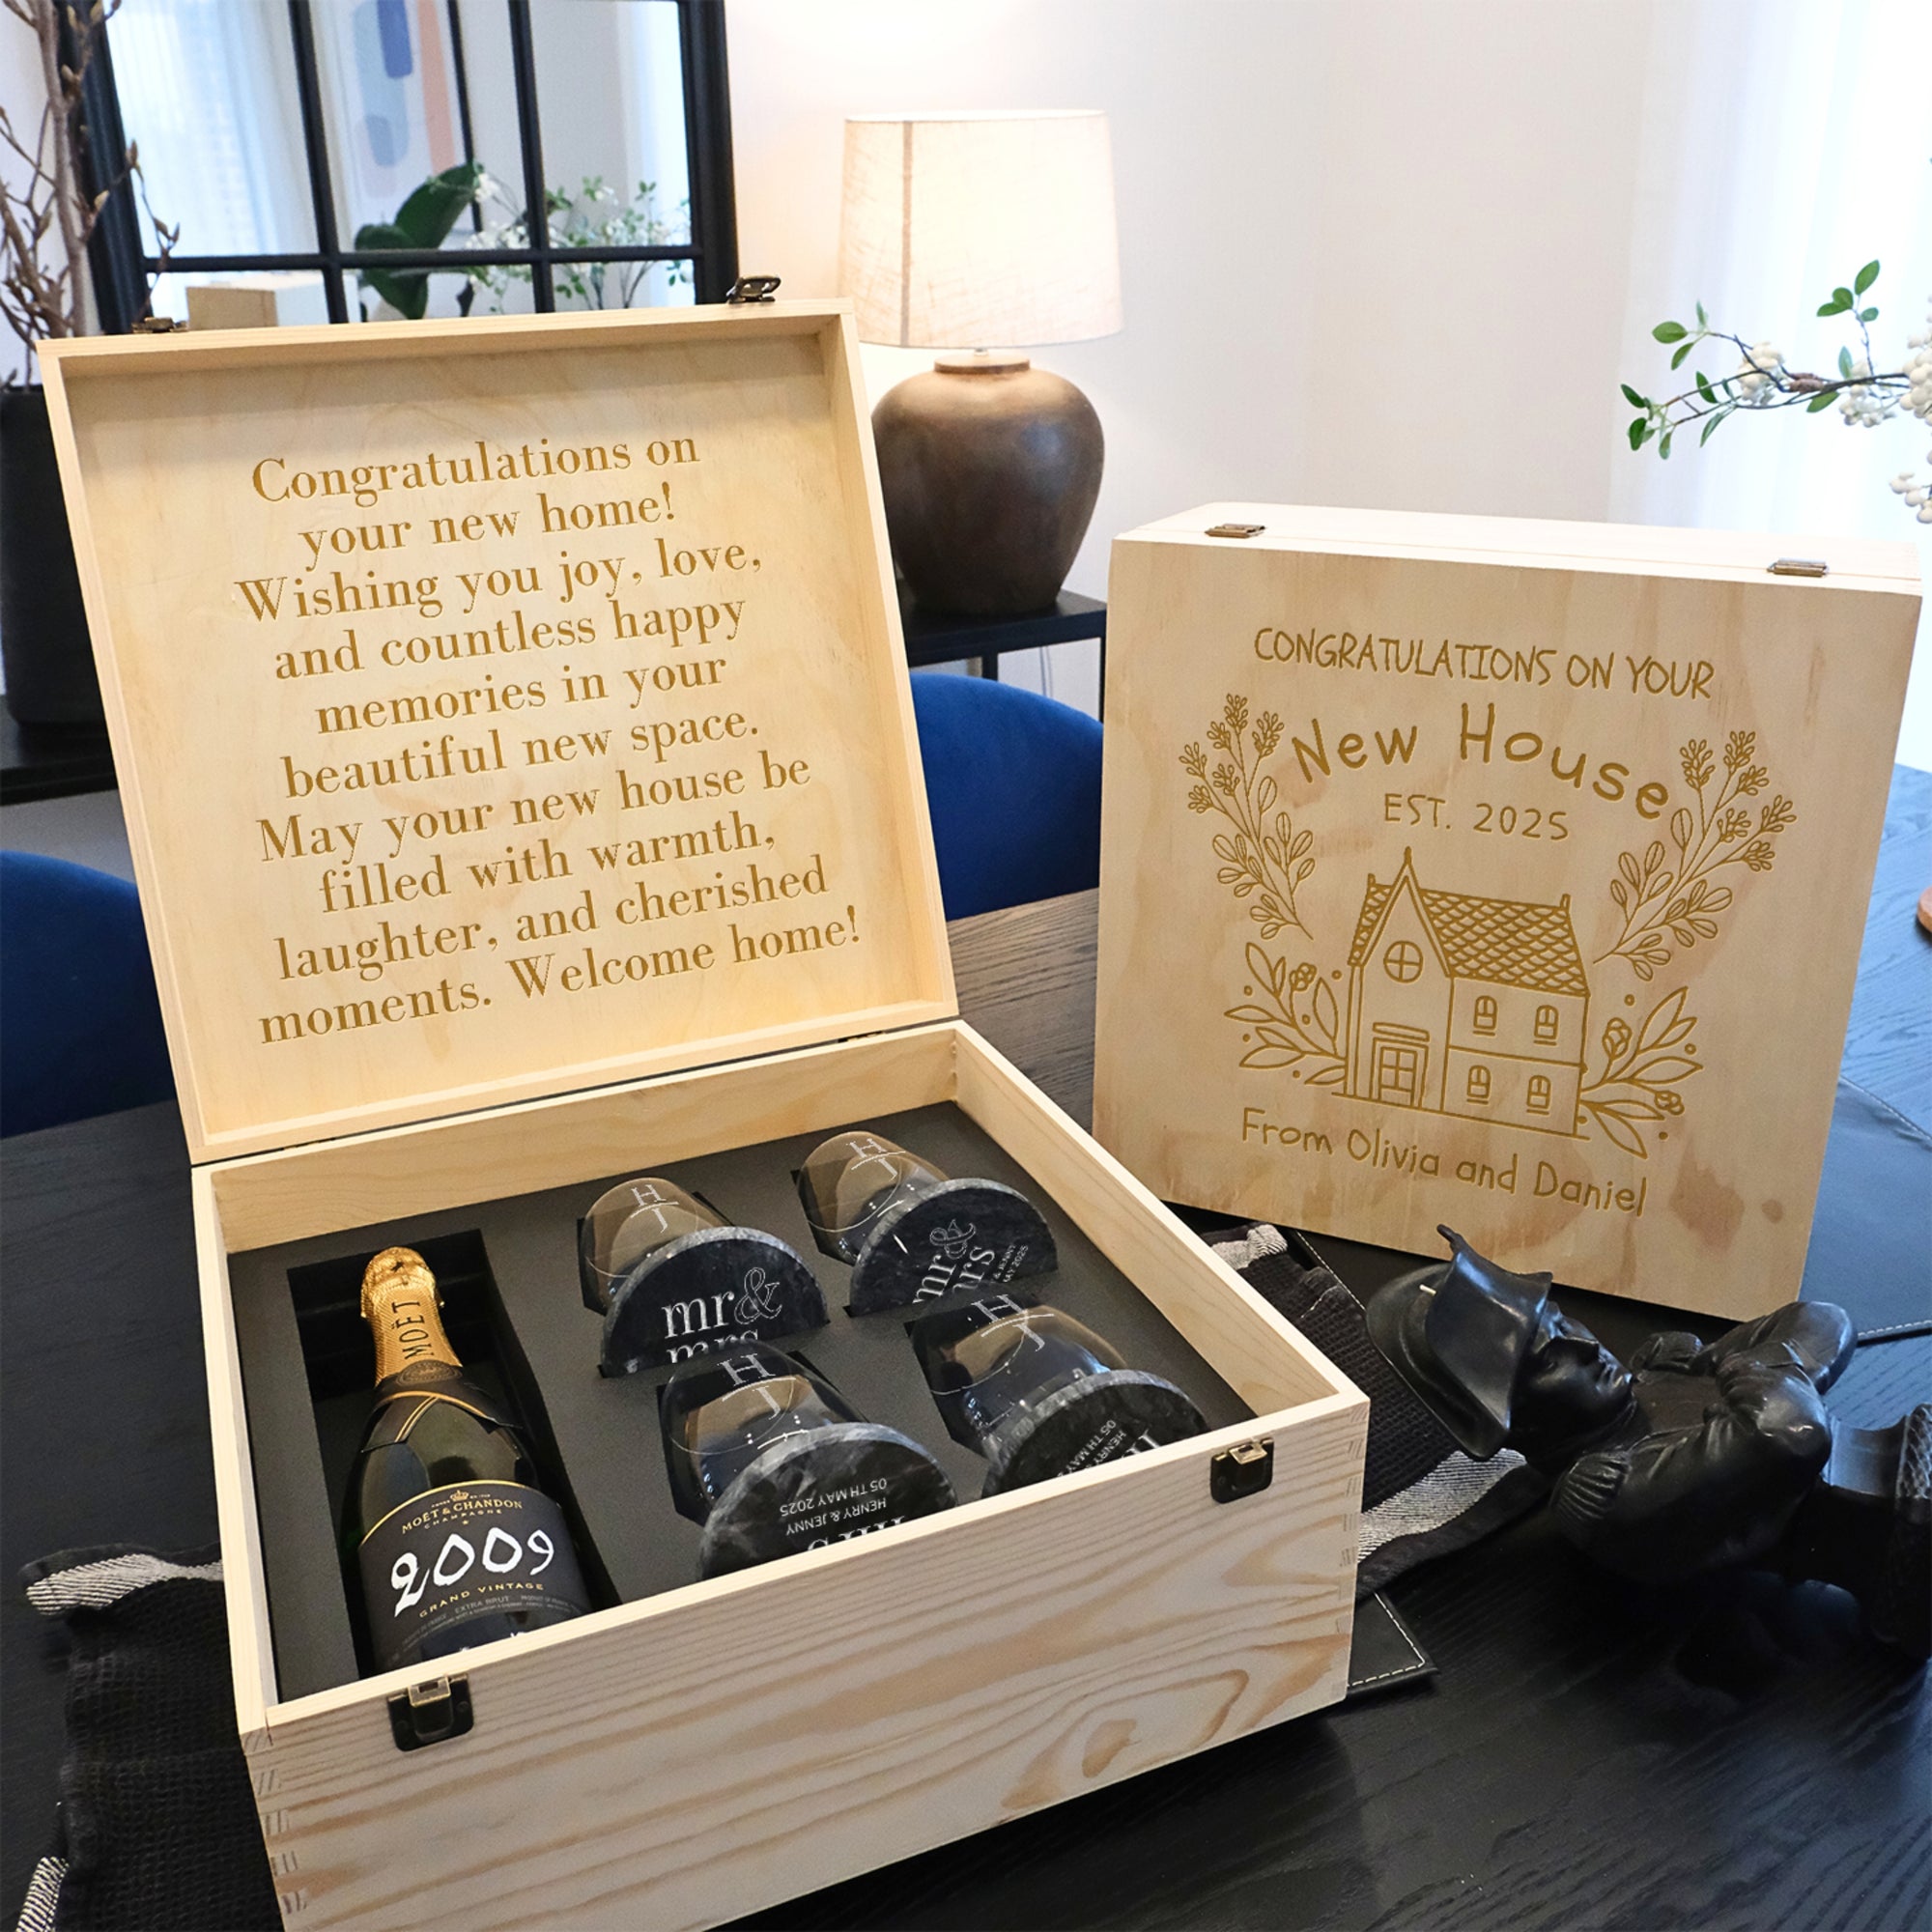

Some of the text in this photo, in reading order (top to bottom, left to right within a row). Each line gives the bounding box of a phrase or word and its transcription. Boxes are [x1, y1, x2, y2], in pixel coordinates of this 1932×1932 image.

[251, 434, 700, 507] Congratulations on
[298, 482, 675, 571] your new home!
[234, 538, 762, 623] Wishing you joy, love,
[275, 598, 746, 679] and countless happy
[1255, 628, 1715, 699] CONGRATULATIONS ON YOUR
[315, 657, 727, 734] memories in your
[280, 709, 758, 799] beautiful new space.
[1292, 702, 1669, 819] New House
[256, 750, 811, 865] May your new house be
[1384, 793, 1570, 840] EST. 2025
[319, 810, 775, 914] filled with warmth,
[273, 854, 830, 981] laughter, and cherished
[259, 904, 860, 1044] moments. Welcome home!
[1242, 1107, 1647, 1217] From Olivia and Daniel
[424, 1508, 502, 1530] CHAMPAGNE
[452, 1498, 524, 1513] CHANDON
[780, 1477, 887, 1518] 05 TH MAY 2025
[785, 1513, 828, 1536] JENNY
[830, 1510, 841, 1520] &
[842, 1498, 887, 1520] HENRY
[390, 1526, 555, 1617] 2009
[418, 1581, 545, 1619] GRAND VINTAGE
[454, 1594, 511, 1615] EXTRA BRUT
